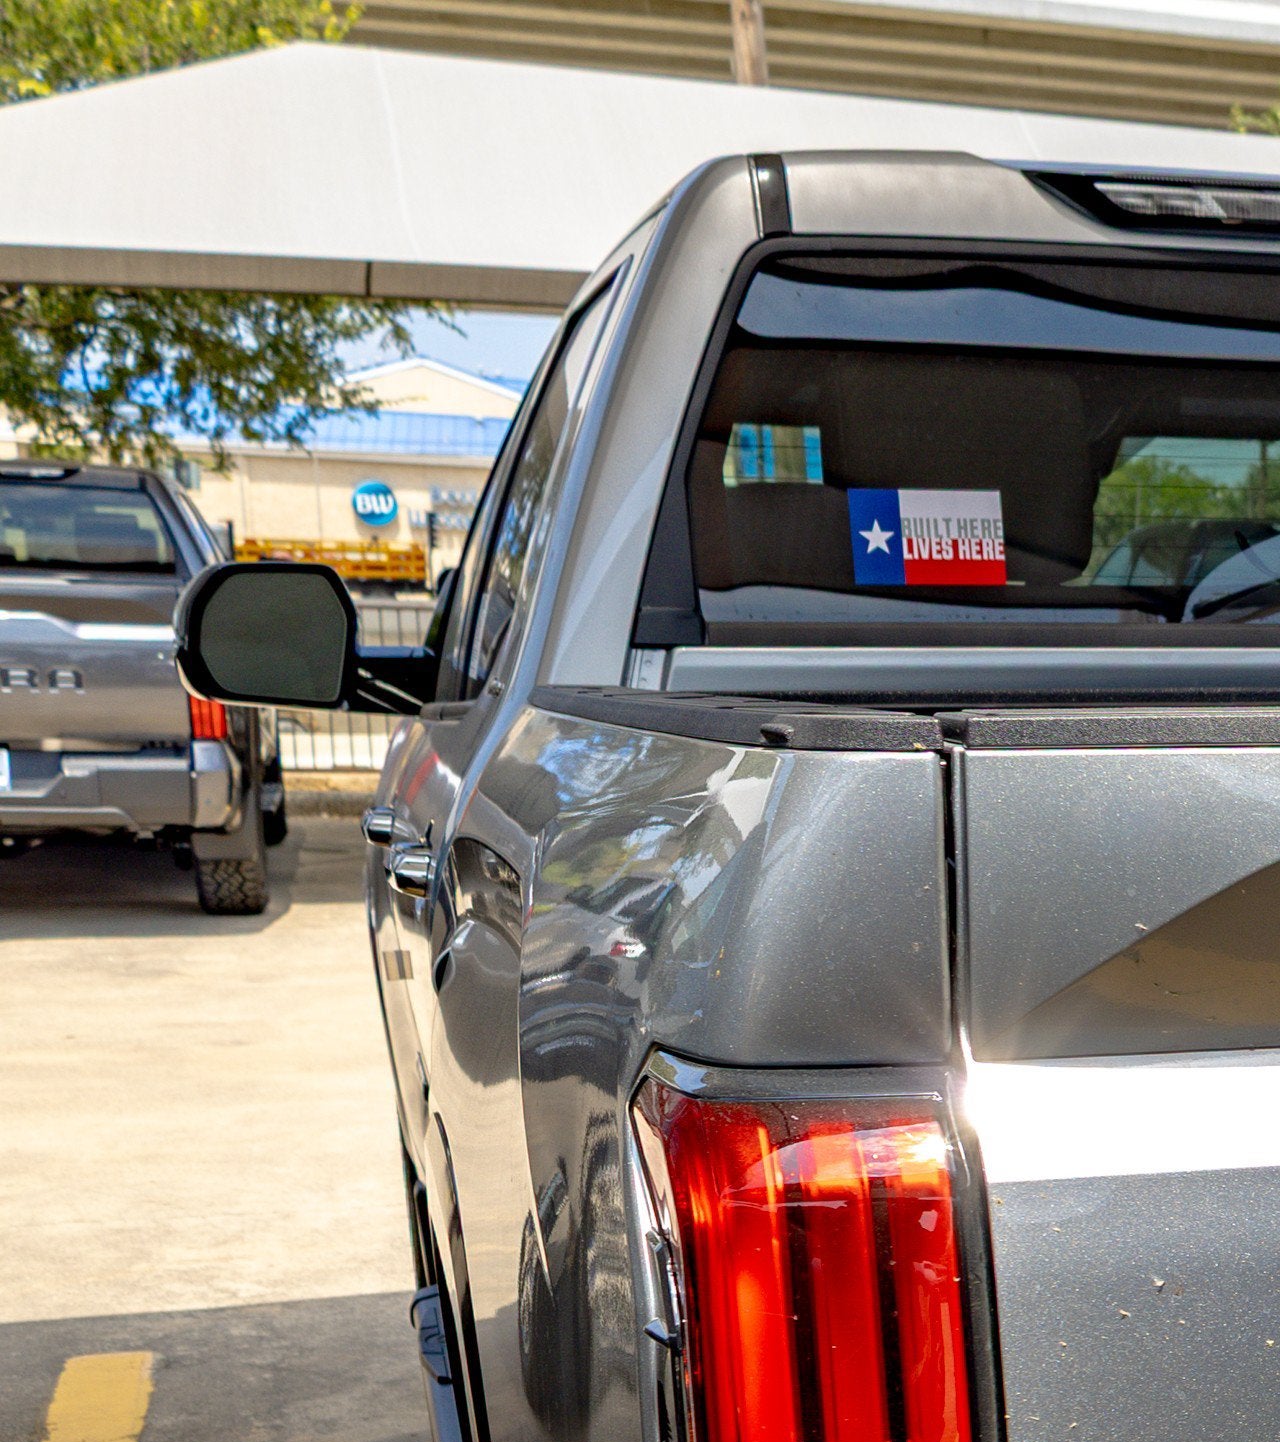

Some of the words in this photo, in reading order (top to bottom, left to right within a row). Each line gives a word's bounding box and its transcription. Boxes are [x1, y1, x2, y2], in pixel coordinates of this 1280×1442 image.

[356, 493, 395, 515] BW
[901, 517, 953, 538] BUILT
[957, 517, 1003, 539] HERE
[903, 538, 954, 560] LIVES
[958, 538, 1005, 560] HERE
